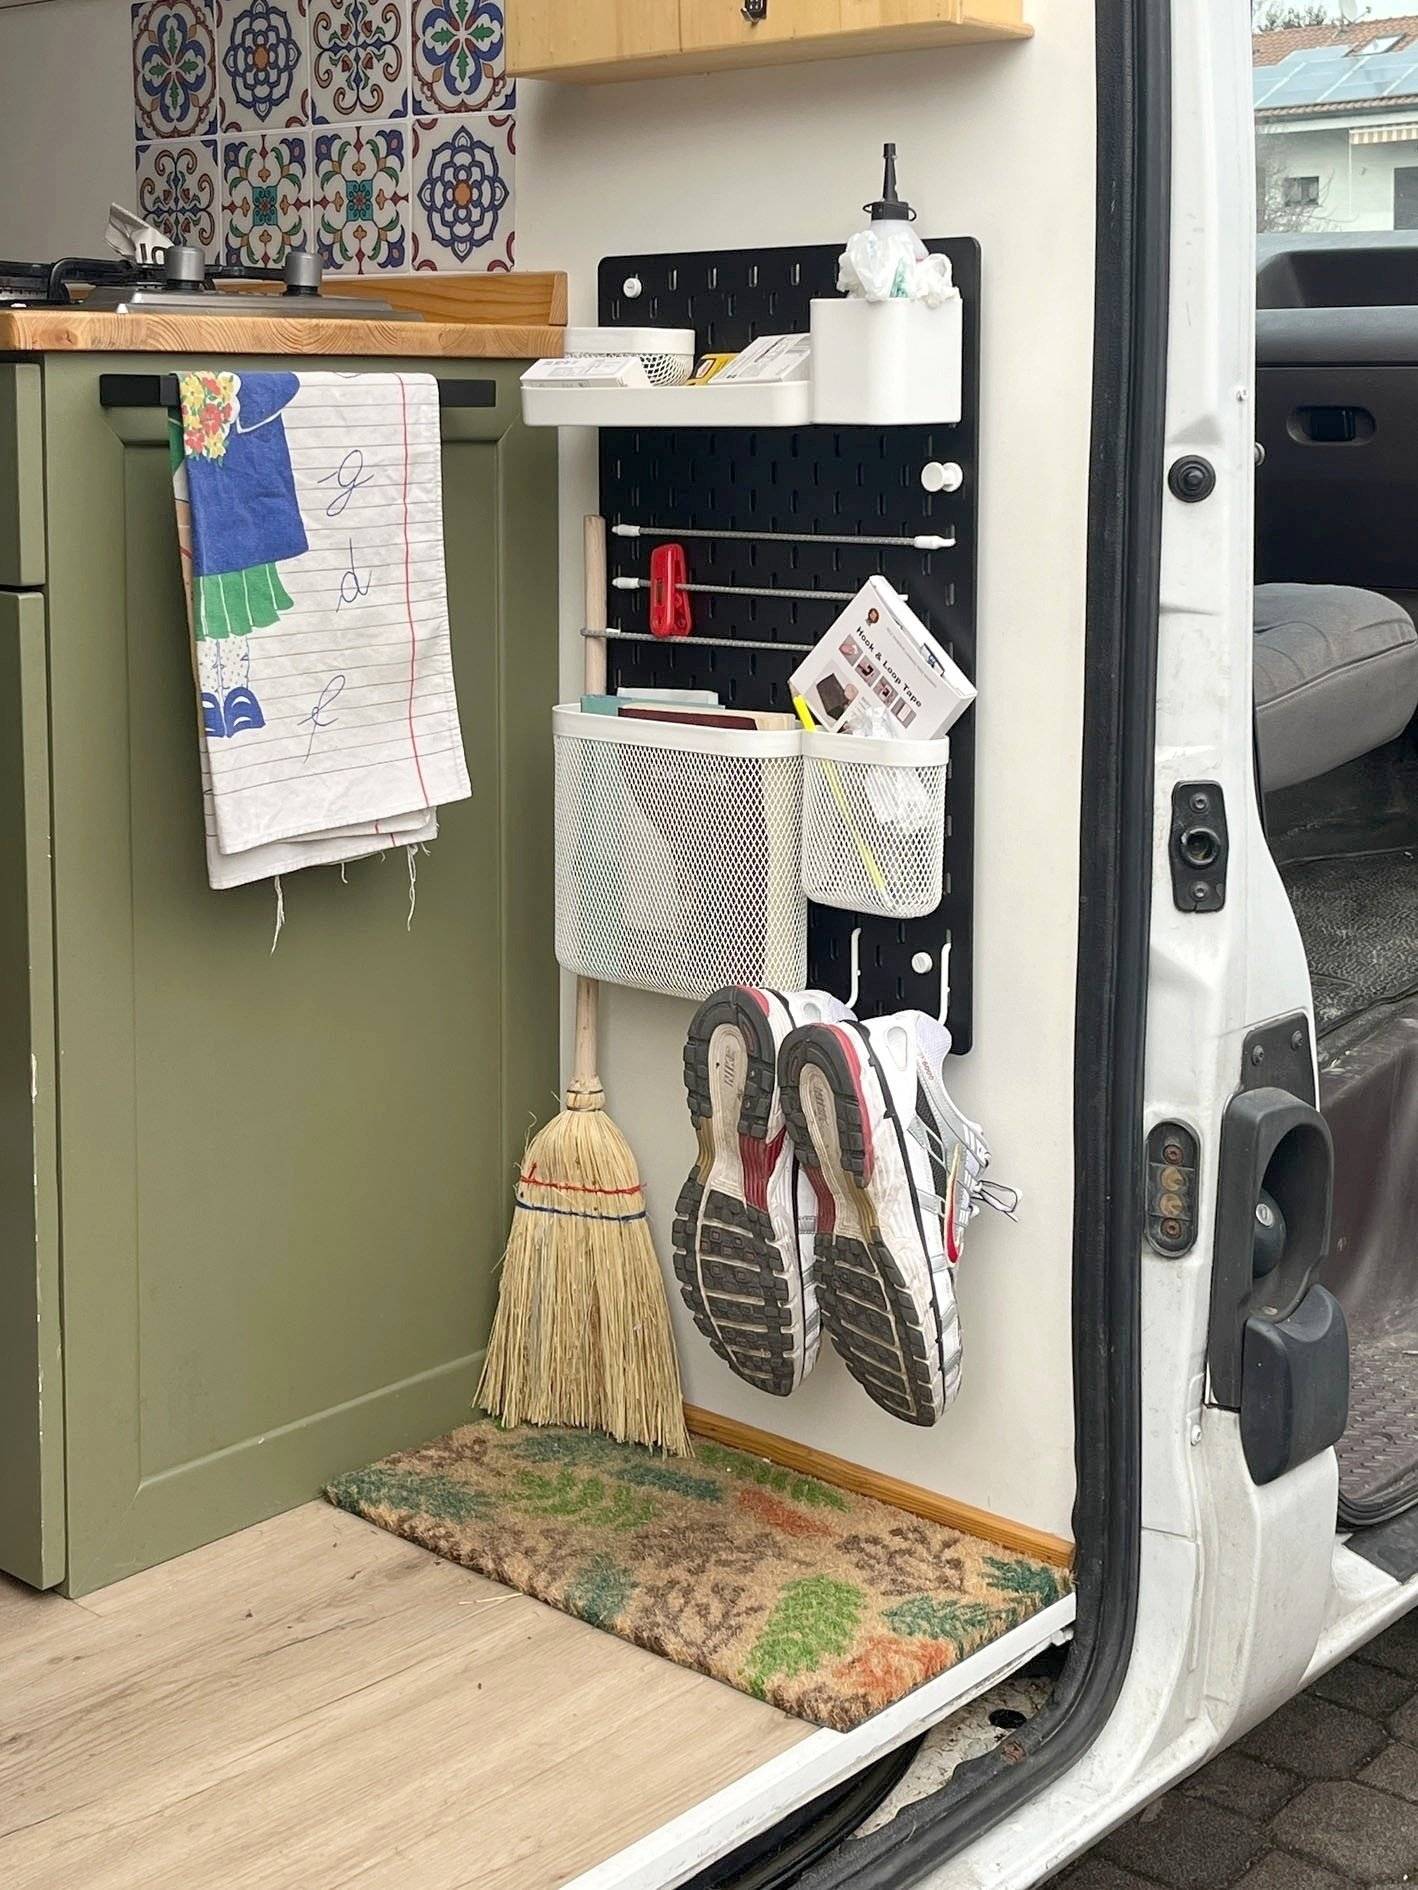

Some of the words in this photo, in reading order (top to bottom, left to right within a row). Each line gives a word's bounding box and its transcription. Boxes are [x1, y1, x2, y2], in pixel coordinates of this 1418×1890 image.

[856, 626, 875, 652] Hook
[875, 652, 882, 661] &
[882, 660, 902, 684] Loop
[903, 683, 922, 707] Tape
